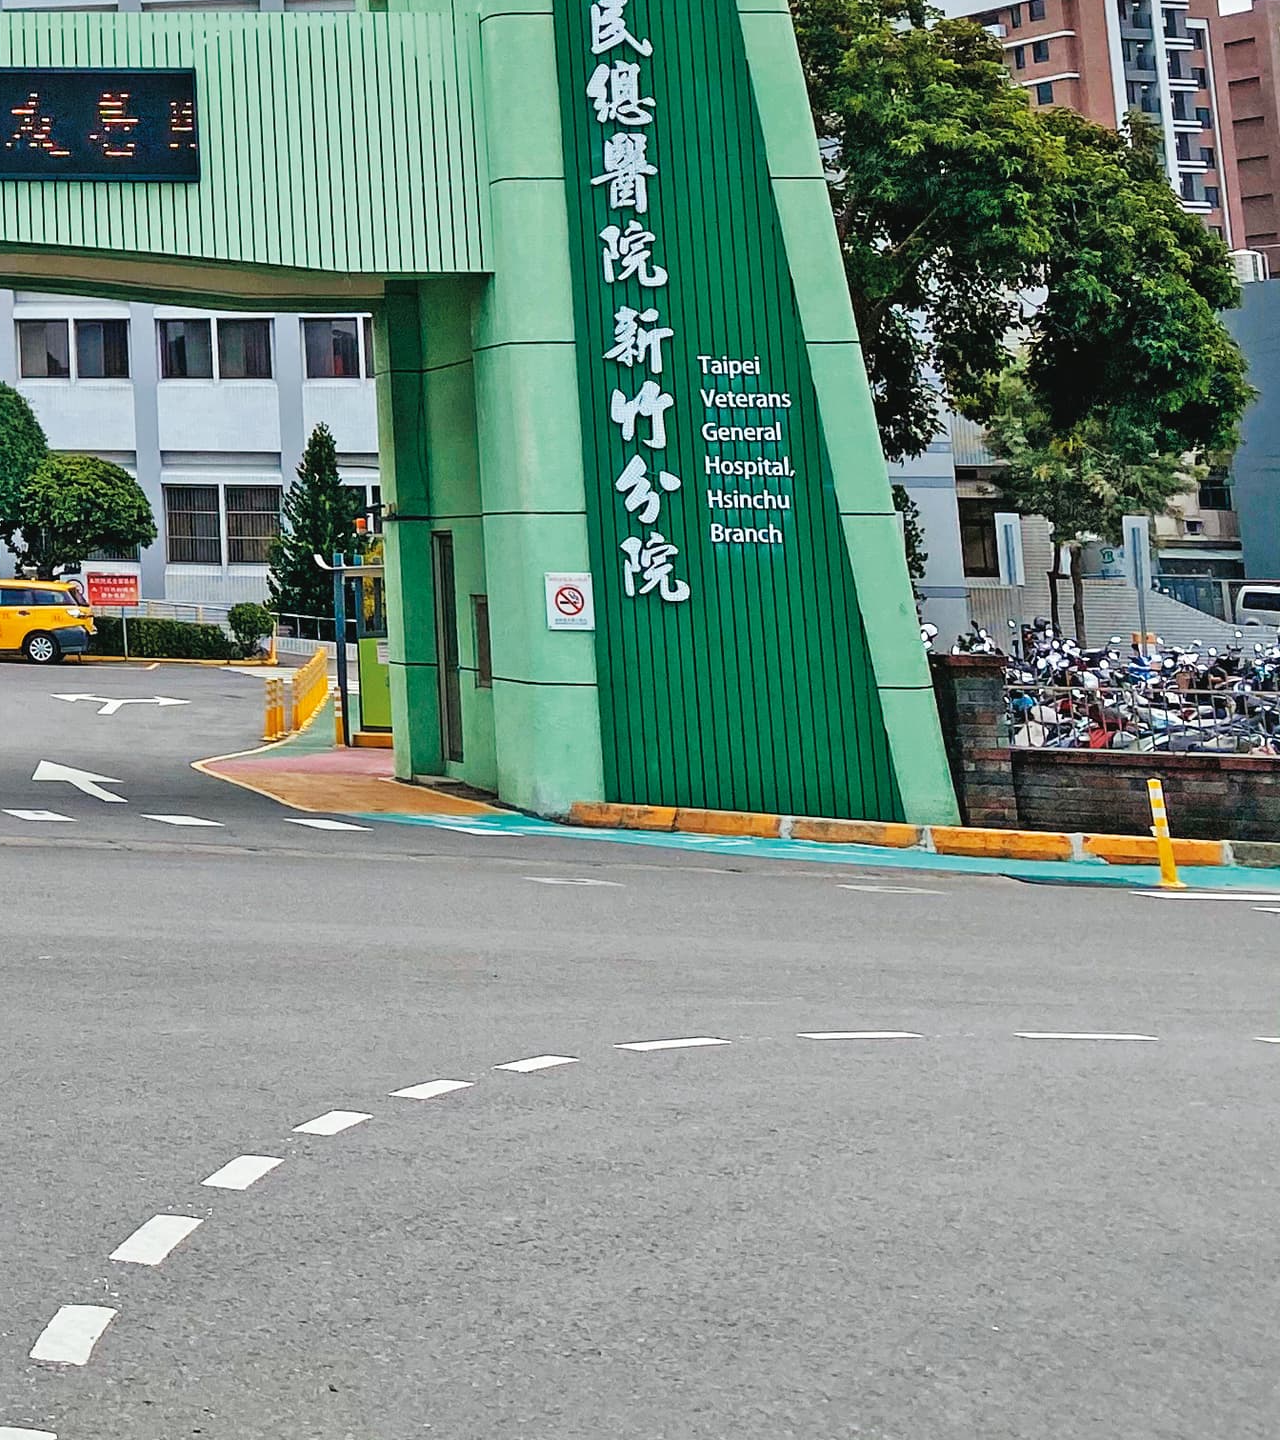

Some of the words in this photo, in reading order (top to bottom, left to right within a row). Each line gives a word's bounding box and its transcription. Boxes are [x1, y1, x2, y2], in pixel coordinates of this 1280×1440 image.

[697, 356, 761, 379] Taipei
[700, 389, 792, 408] Veterans
[701, 422, 782, 441] General
[705, 455, 796, 480] Hospital,
[707, 489, 791, 509] Hsinchu
[710, 523, 783, 544] Branch
